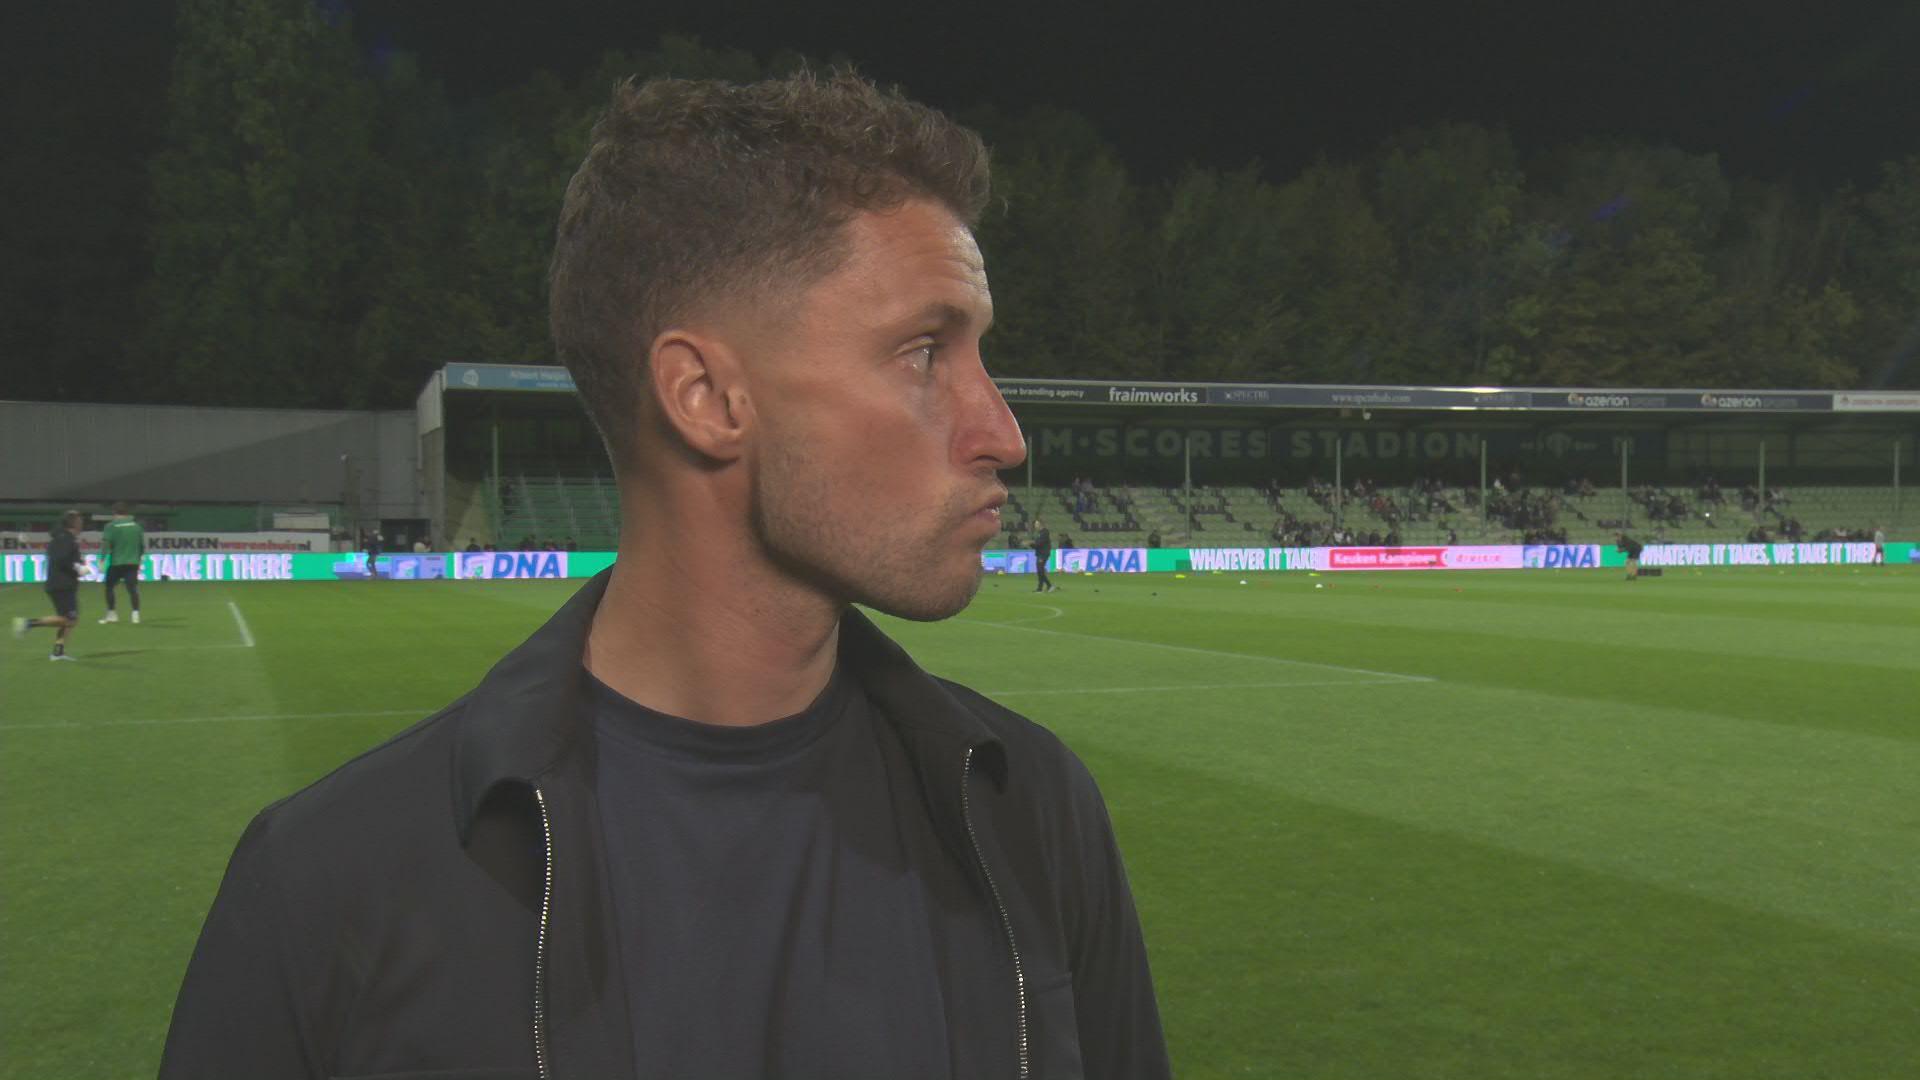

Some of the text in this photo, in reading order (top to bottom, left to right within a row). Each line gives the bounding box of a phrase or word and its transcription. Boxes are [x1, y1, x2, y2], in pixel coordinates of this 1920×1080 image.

[1019, 387, 1054, 398] branding
[1056, 389, 1084, 398] agency
[1109, 387, 1198, 403] fraimworks
[1585, 394, 1630, 407] azerion
[1718, 396, 1762, 408] azerion
[1292, 430, 1480, 459] STADION
[1085, 550, 1141, 572] DNA
[1189, 548, 1265, 570] WHATEVER
[1269, 548, 1282, 570] IT
[1545, 547, 1596, 567] DNA
[1640, 544, 1710, 565] WHATEVER
[1713, 544, 1726, 564] IT
[1772, 544, 1795, 564] WE
[1797, 543, 1828, 564] TAKE
[1830, 543, 1843, 564] IT
[5, 554, 26, 581] IT
[150, 554, 202, 580] TAKE
[206, 554, 225, 580] IT
[230, 554, 293, 579] THERE
[493, 554, 562, 577] DNA
